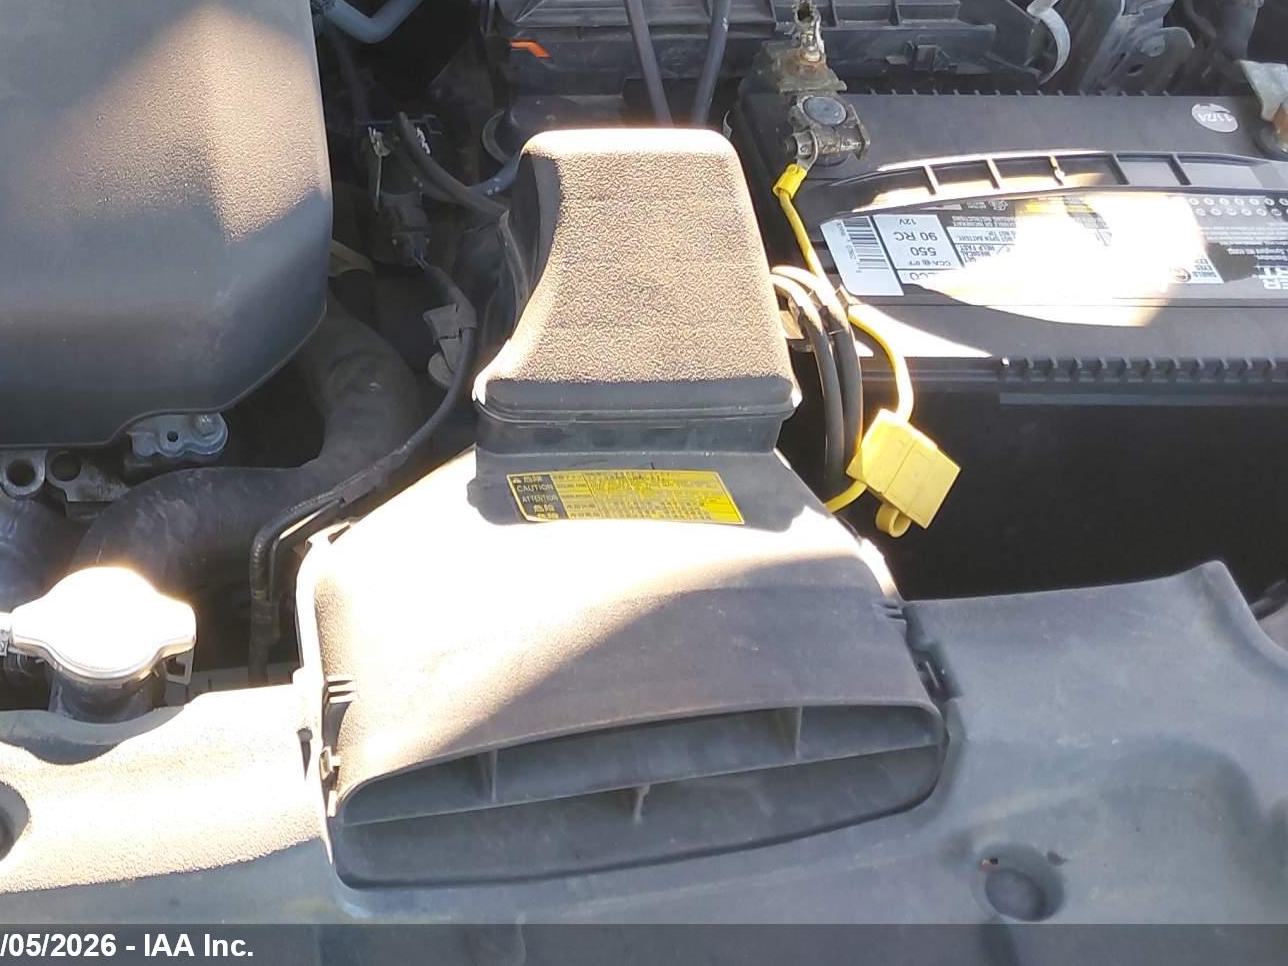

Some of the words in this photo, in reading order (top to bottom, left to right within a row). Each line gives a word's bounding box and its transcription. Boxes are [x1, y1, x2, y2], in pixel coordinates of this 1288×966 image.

[894, 232, 916, 242] RC
[920, 232, 938, 242] 90
[909, 246, 937, 256] 550
[516, 484, 554, 492] CAUTION
